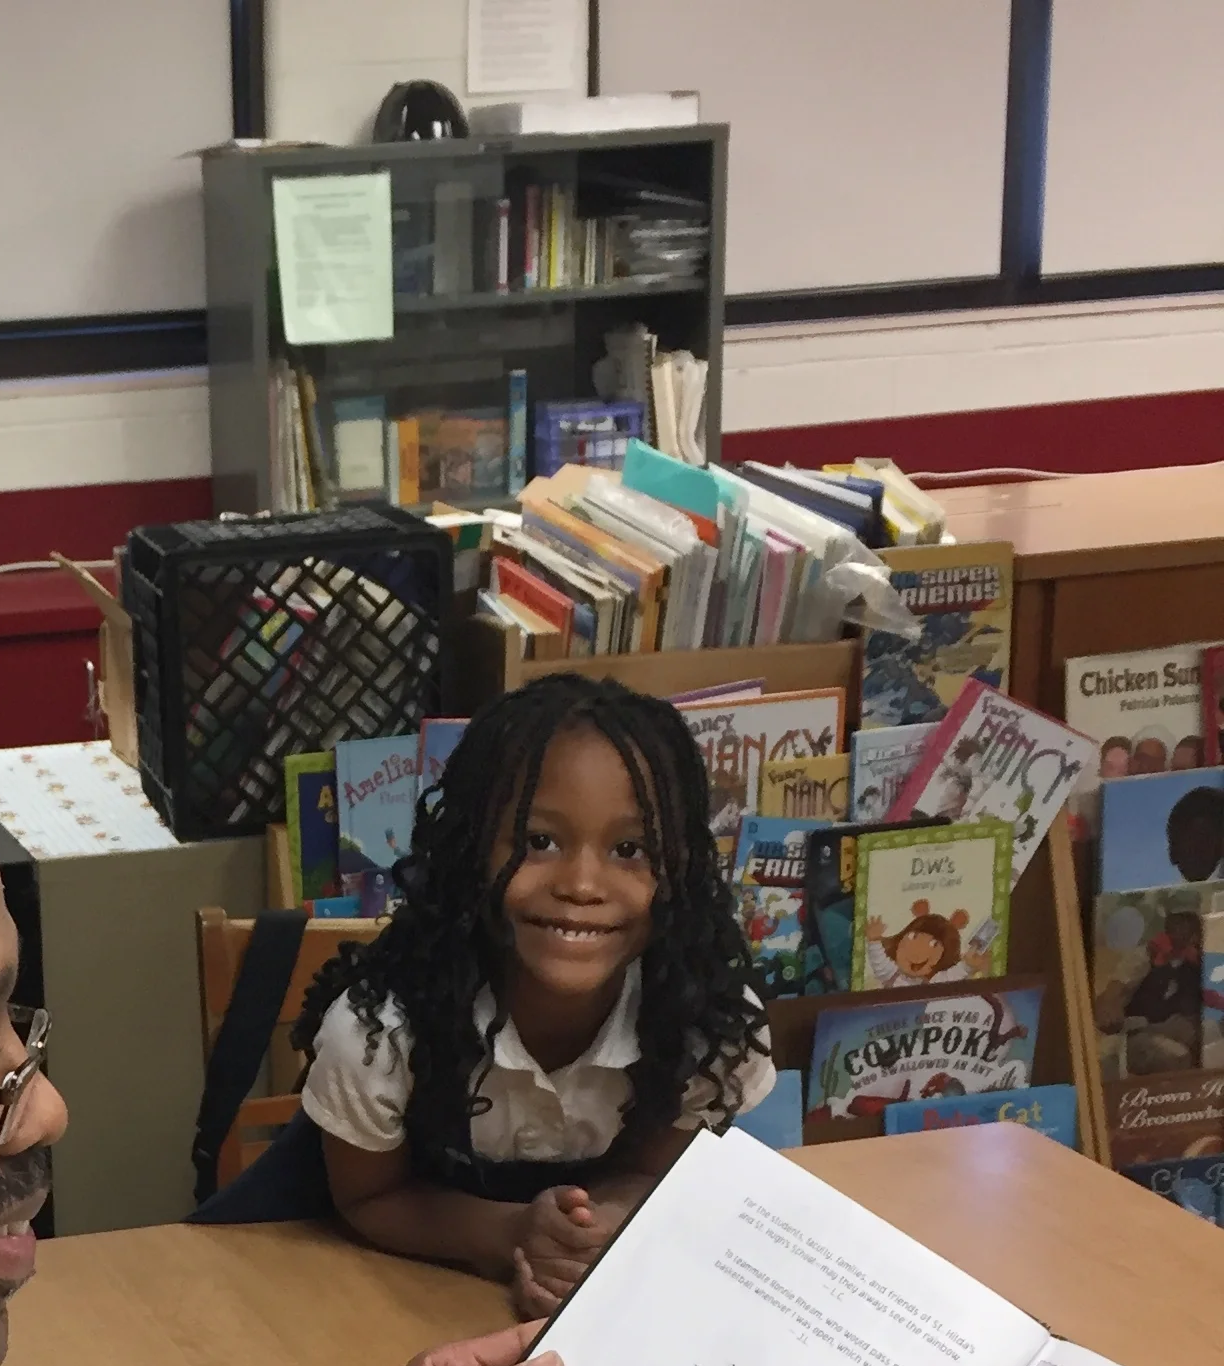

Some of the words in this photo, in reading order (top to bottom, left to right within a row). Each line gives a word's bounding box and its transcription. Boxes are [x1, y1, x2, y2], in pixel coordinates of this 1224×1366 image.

[1079, 667, 1159, 698] Chicken
[1163, 662, 1201, 688] Sun
[343, 752, 418, 809] Amelia
[782, 775, 851, 819] NANC
[746, 856, 806, 880] FRIE
[843, 1025, 1000, 1076] COWPOKE
[998, 1100, 1044, 1124] Cat
[1119, 1086, 1192, 1109] Brown
[756, 1205, 771, 1219] the
[868, 1279, 888, 1295] and
[887, 1290, 919, 1316] friends
[733, 1256, 771, 1283] teammate
[825, 1317, 844, 1333] who
[843, 1330, 871, 1351] would
[868, 1348, 891, 1366] pass
[754, 1287, 792, 1314] whenever
[795, 1315, 811, 1330] was
[836, 1342, 862, 1364] which
[838, 1275, 859, 1294] they
[858, 1291, 888, 1313] always
[888, 1309, 906, 1324] see
[905, 1320, 923, 1335] the
